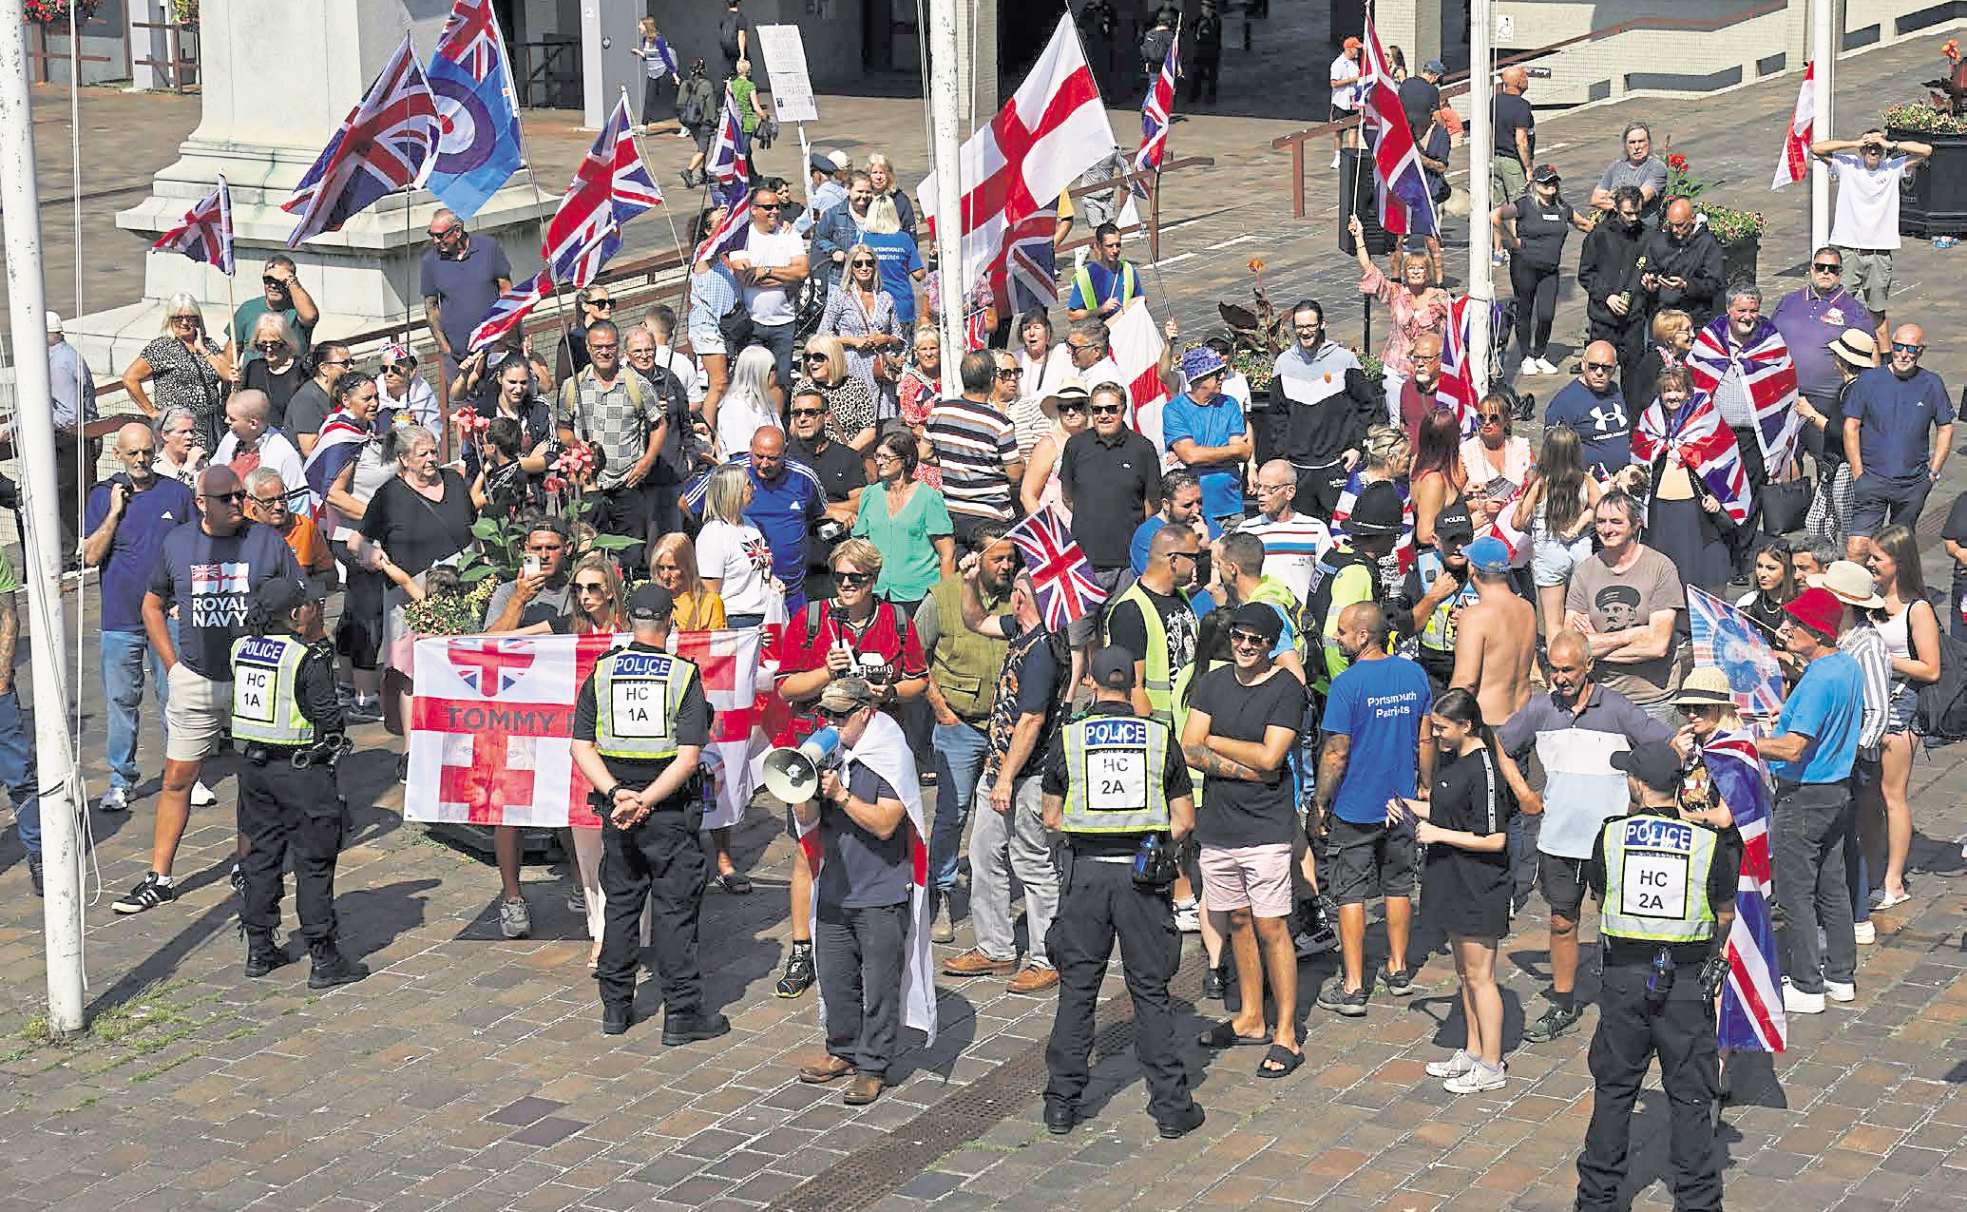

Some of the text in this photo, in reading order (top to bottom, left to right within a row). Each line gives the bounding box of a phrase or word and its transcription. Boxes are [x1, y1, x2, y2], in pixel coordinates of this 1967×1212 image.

[193, 596, 248, 611] ROYAL
[193, 611, 248, 627] NAVY
[240, 640, 282, 660] POLICE
[614, 657, 671, 674] POLICE
[247, 673, 266, 688] HC
[243, 693, 261, 707] 1A
[626, 687, 649, 701] HC
[447, 706, 557, 732] TOMMY
[628, 708, 649, 721] 1A
[1085, 724, 1146, 742] POLICE
[1103, 758, 1129, 773] HC
[1101, 780, 1125, 794] 2A
[1626, 824, 1691, 850] POLICE
[1640, 870, 1668, 887] HC
[1638, 893, 1664, 910] 2A
